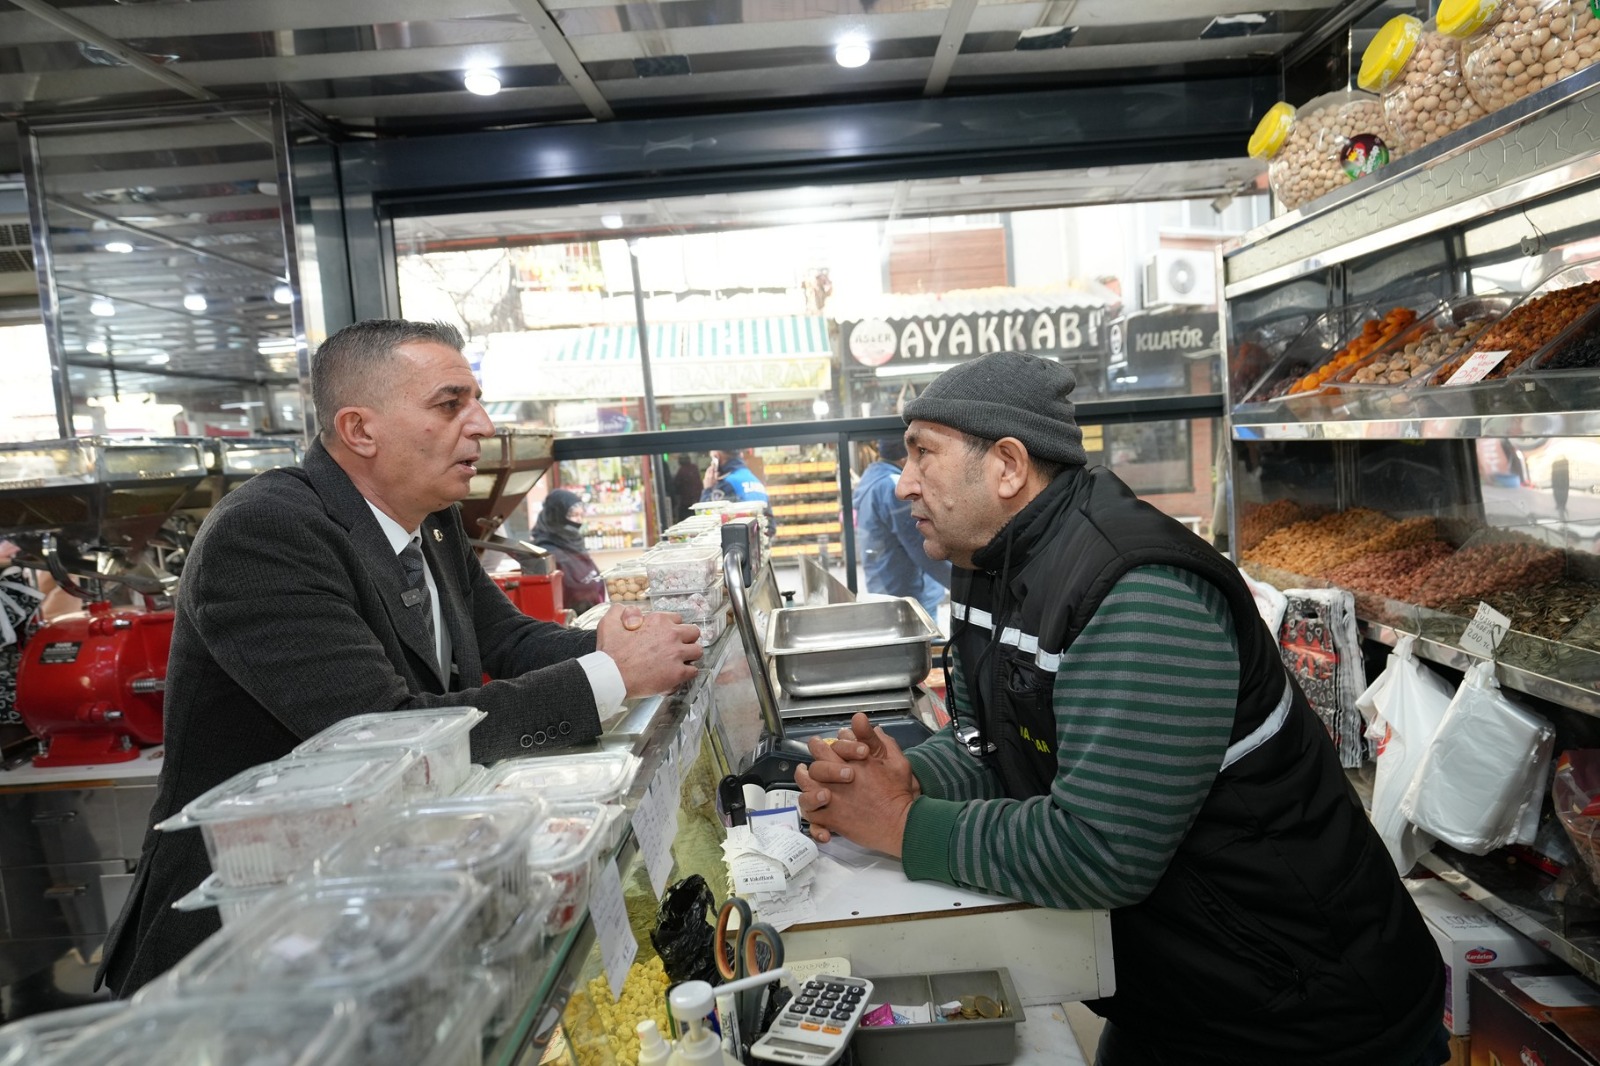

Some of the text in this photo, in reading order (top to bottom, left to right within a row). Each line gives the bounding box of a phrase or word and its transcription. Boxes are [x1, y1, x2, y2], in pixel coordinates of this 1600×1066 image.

[1136, 325, 1204, 352] KUAFÖR
[670, 361, 825, 390] BAHARAT
[1465, 952, 1493, 961] Kardelen
